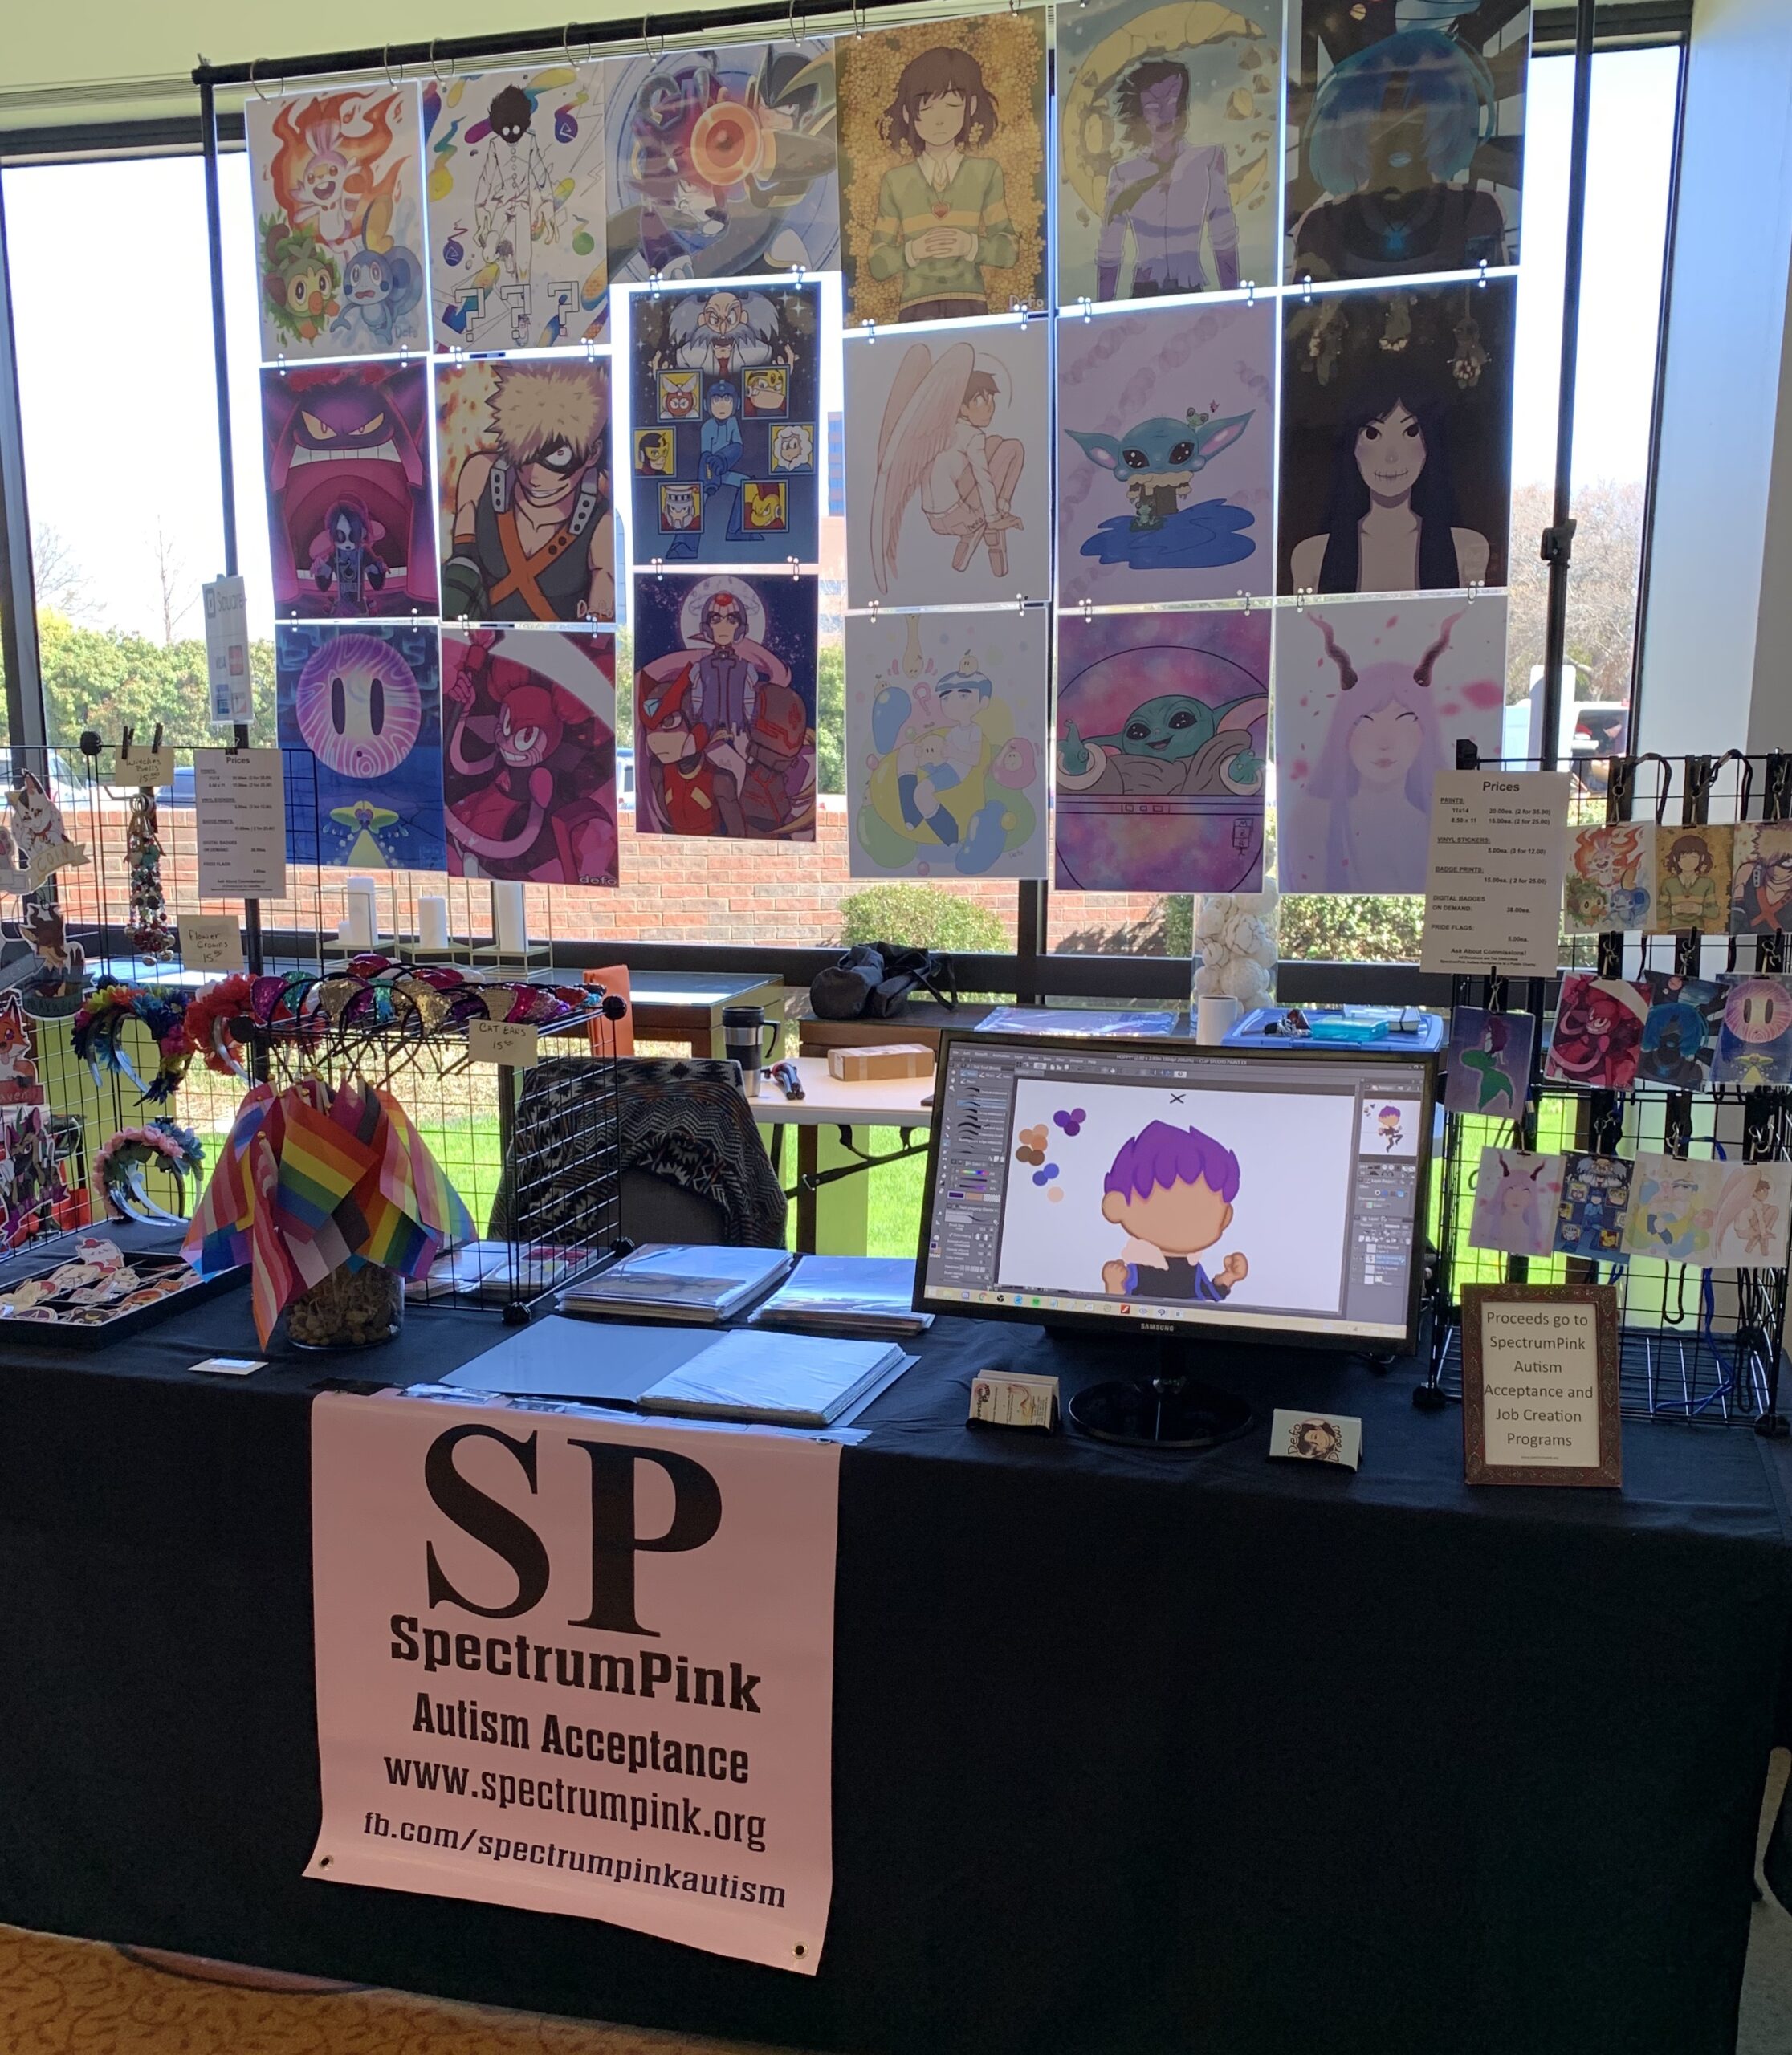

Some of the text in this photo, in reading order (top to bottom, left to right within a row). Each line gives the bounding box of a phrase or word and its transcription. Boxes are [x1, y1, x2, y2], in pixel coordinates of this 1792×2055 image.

[226, 756, 250, 764] Prices
[1482, 781, 1520, 792] Prices
[37, 846, 69, 872] COIN
[579, 875, 617, 885] defo
[479, 1022, 527, 1037] CAT EARS
[1141, 1323, 1174, 1332] SAMSUNG
[1487, 1312, 1588, 1328] Proceeds go to
[1489, 1336, 1586, 1350] SpectrumPink
[1513, 1361, 1562, 1373] Autism
[1484, 1384, 1593, 1398] Acceptance and
[1496, 1408, 1582, 1422] Job Creation
[1287, 1423, 1302, 1455] Defo
[1328, 1425, 1343, 1462] Draws
[1507, 1433, 1572, 1448] Programs
[424, 1423, 723, 1638] SP
[390, 1613, 762, 1713] SpectrumPink
[412, 1691, 750, 1784] Autism Acceptance
[384, 1755, 767, 1853] www.spectrumpink.org
[364, 1812, 786, 1909] fb.com/spectrumpinkautism
